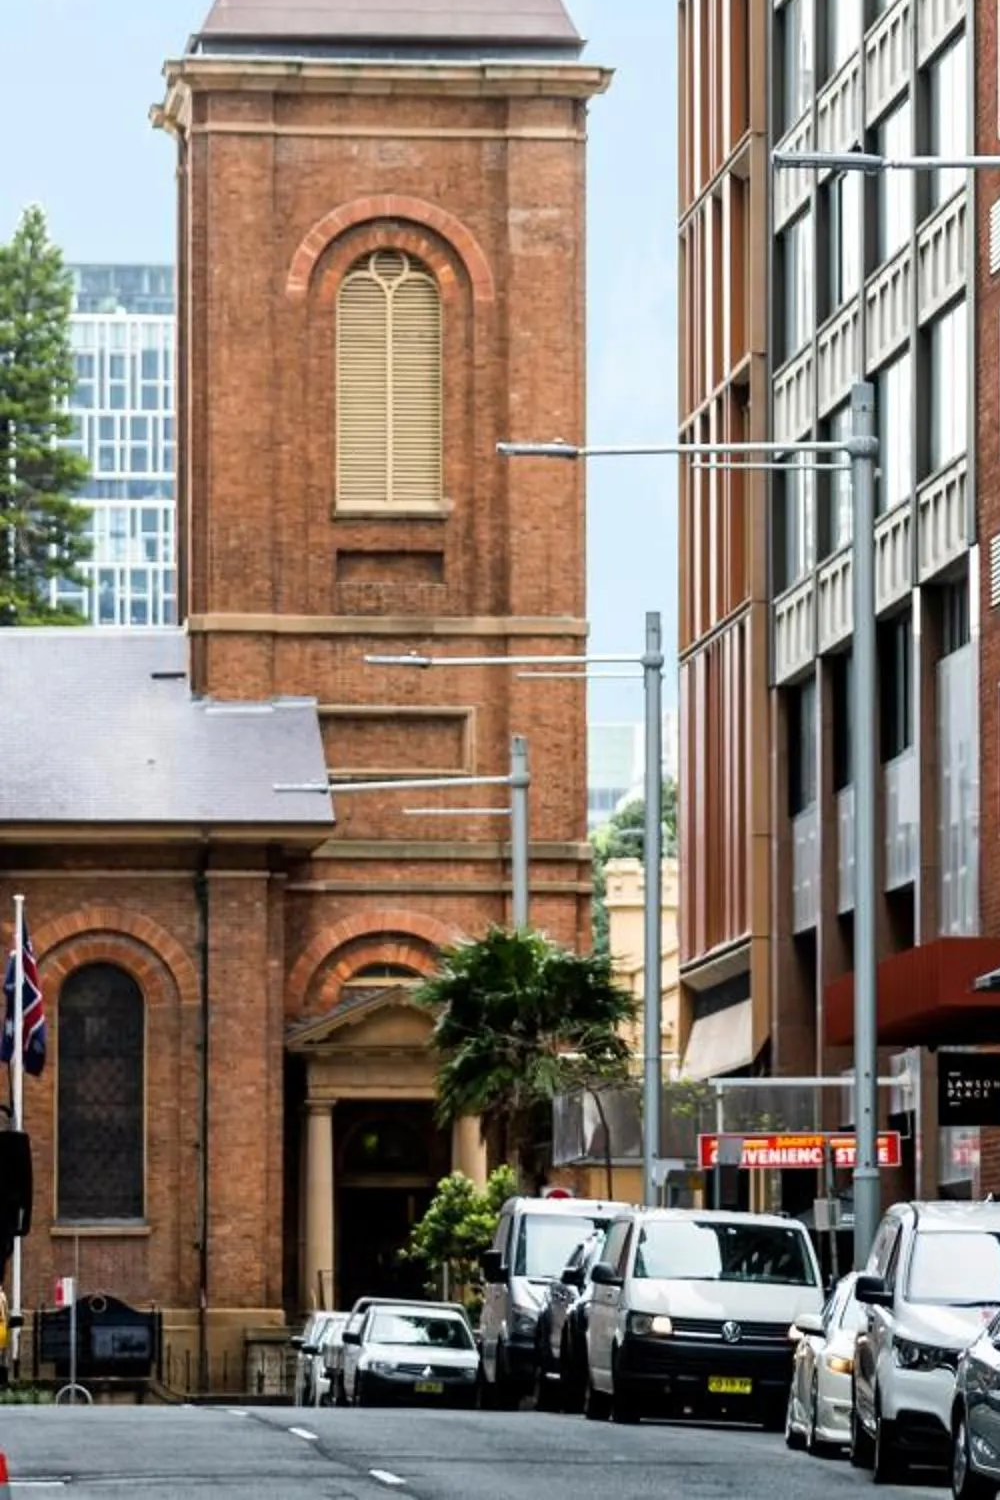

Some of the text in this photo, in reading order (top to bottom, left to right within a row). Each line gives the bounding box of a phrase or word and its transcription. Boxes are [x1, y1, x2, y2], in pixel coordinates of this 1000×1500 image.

[947, 1080, 1000, 1089] LAWSON
[947, 1089, 990, 1098] PLACE
[711, 1147, 889, 1165] CVENIENC STE
